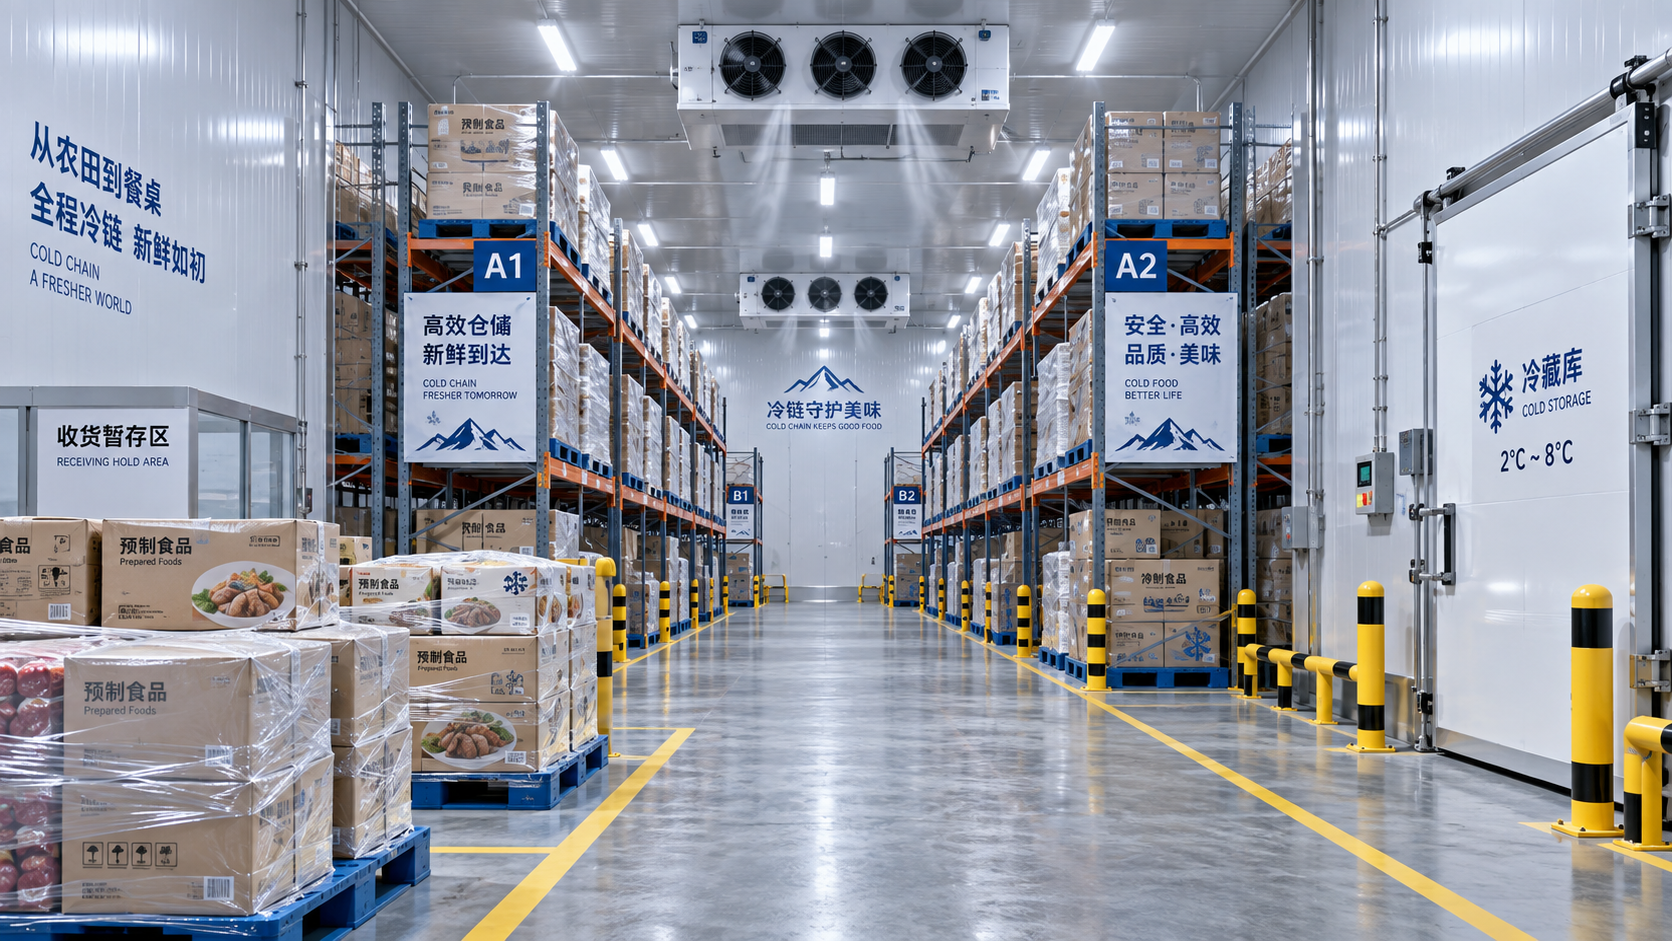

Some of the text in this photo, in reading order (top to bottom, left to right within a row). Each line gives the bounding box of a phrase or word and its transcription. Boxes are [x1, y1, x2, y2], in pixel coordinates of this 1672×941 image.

[30, 120, 162, 217] 从农田到餐桌
[30, 181, 206, 284] 全程冷链 新鲜如初
[30, 242, 100, 281] COLD CHAIN
[484, 252, 521, 279] A1
[1115, 252, 1157, 279] A2
[30, 269, 132, 315] A FRESHER WORLD
[1124, 314, 1221, 337] 安全·高效
[422, 343, 512, 366] 新鲜到达
[1124, 343, 1222, 366] 品质·美味
[1522, 347, 1583, 394] 冷藏库
[423, 379, 477, 388] COLD CHAIN
[1124, 379, 1179, 388] COLD FOOD
[423, 391, 518, 400] FRESHER TOMORROW
[1124, 391, 1183, 400] BETTER LIFE
[1522, 390, 1592, 418] COLD STORAGE
[766, 400, 882, 420] 冷链守护美味
[57, 424, 170, 448] 收货暂存区
[57, 457, 170, 467] RECEIVING HOLD AREA
[1500, 447, 1526, 473] 2°C
[1545, 439, 1574, 467] 8°C
[733, 490, 748, 502] B1
[899, 490, 915, 502] B2
[0, 536, 31, 555] 食品
[119, 536, 192, 555] 预制食品
[119, 557, 183, 568] Prepared Foods
[83, 680, 168, 703] 预制食品
[83, 705, 157, 718] Prepared Foods
